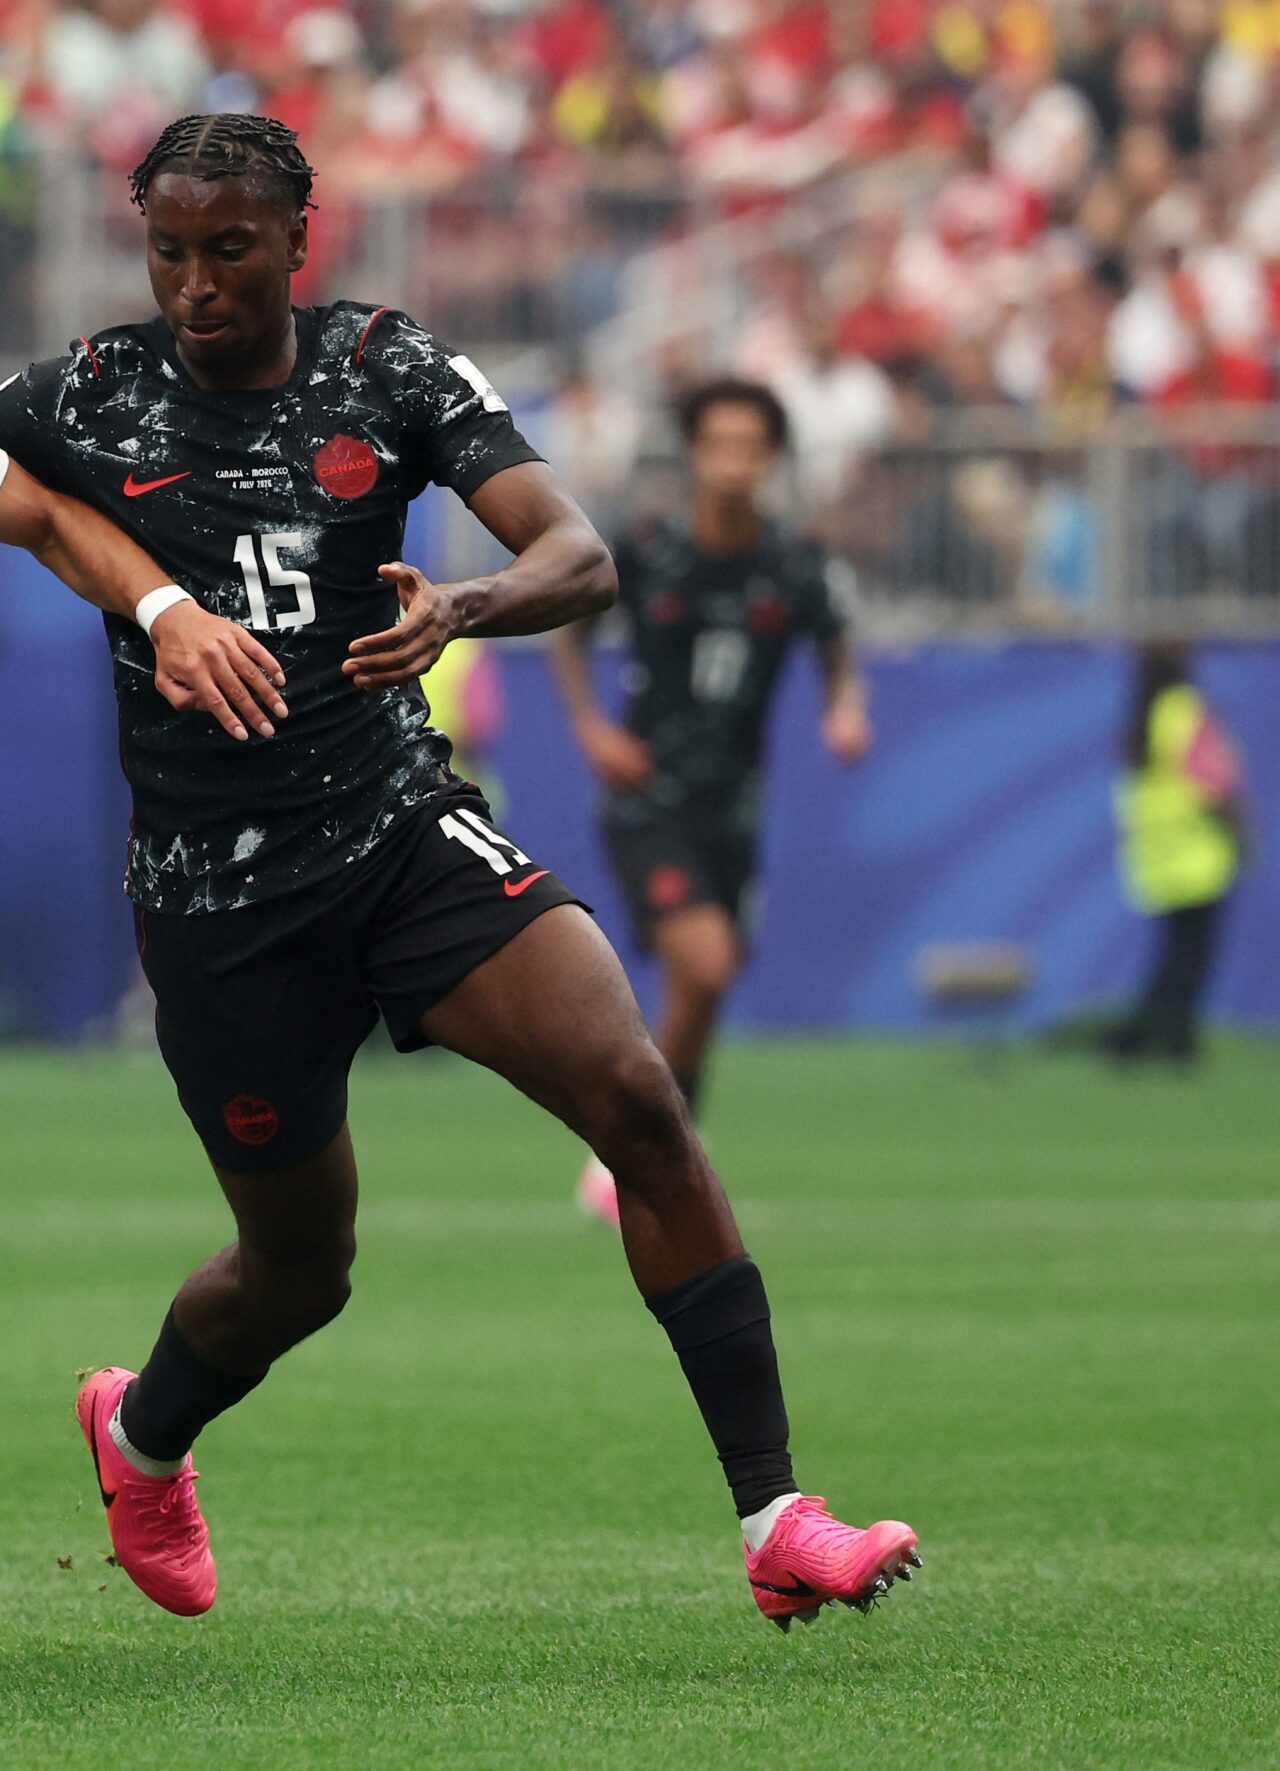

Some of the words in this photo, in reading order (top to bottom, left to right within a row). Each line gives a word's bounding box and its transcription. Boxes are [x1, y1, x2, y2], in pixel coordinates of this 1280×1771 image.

[215, 469, 244, 478] CANADA
[252, 467, 288, 477] MOROCCO
[320, 458, 374, 477] CANADA
[239, 480, 254, 489] JULY
[233, 532, 316, 630] 15
